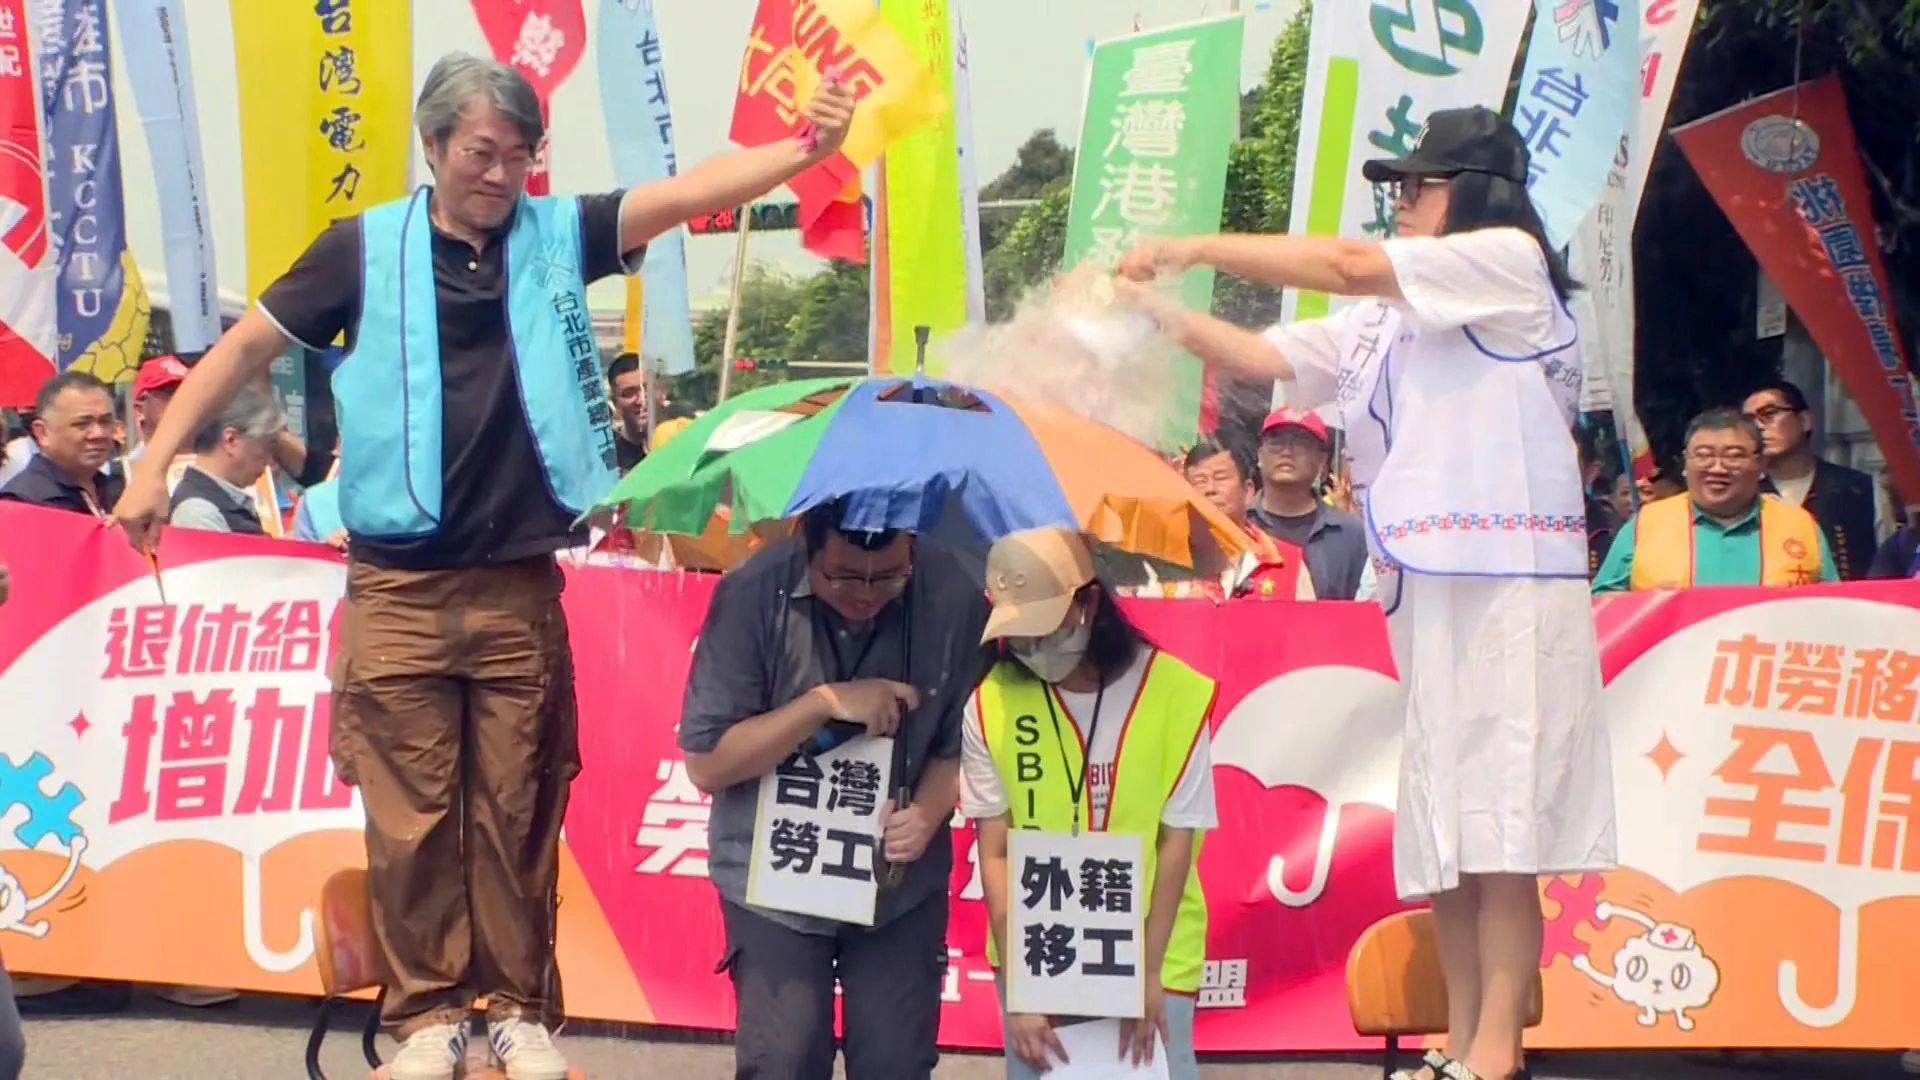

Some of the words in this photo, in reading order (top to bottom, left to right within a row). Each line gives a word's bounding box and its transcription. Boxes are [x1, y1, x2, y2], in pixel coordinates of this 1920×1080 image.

[314, 0, 365, 204] 台灣電力
[71, 143, 104, 318] KCCTU
[108, 687, 355, 825] 增加
[775, 752, 881, 817] 台灣
[1015, 714, 1044, 830] SBI
[769, 818, 875, 882] 勞工
[1020, 856, 1133, 913] 外籍
[1024, 923, 1136, 978] 移工
